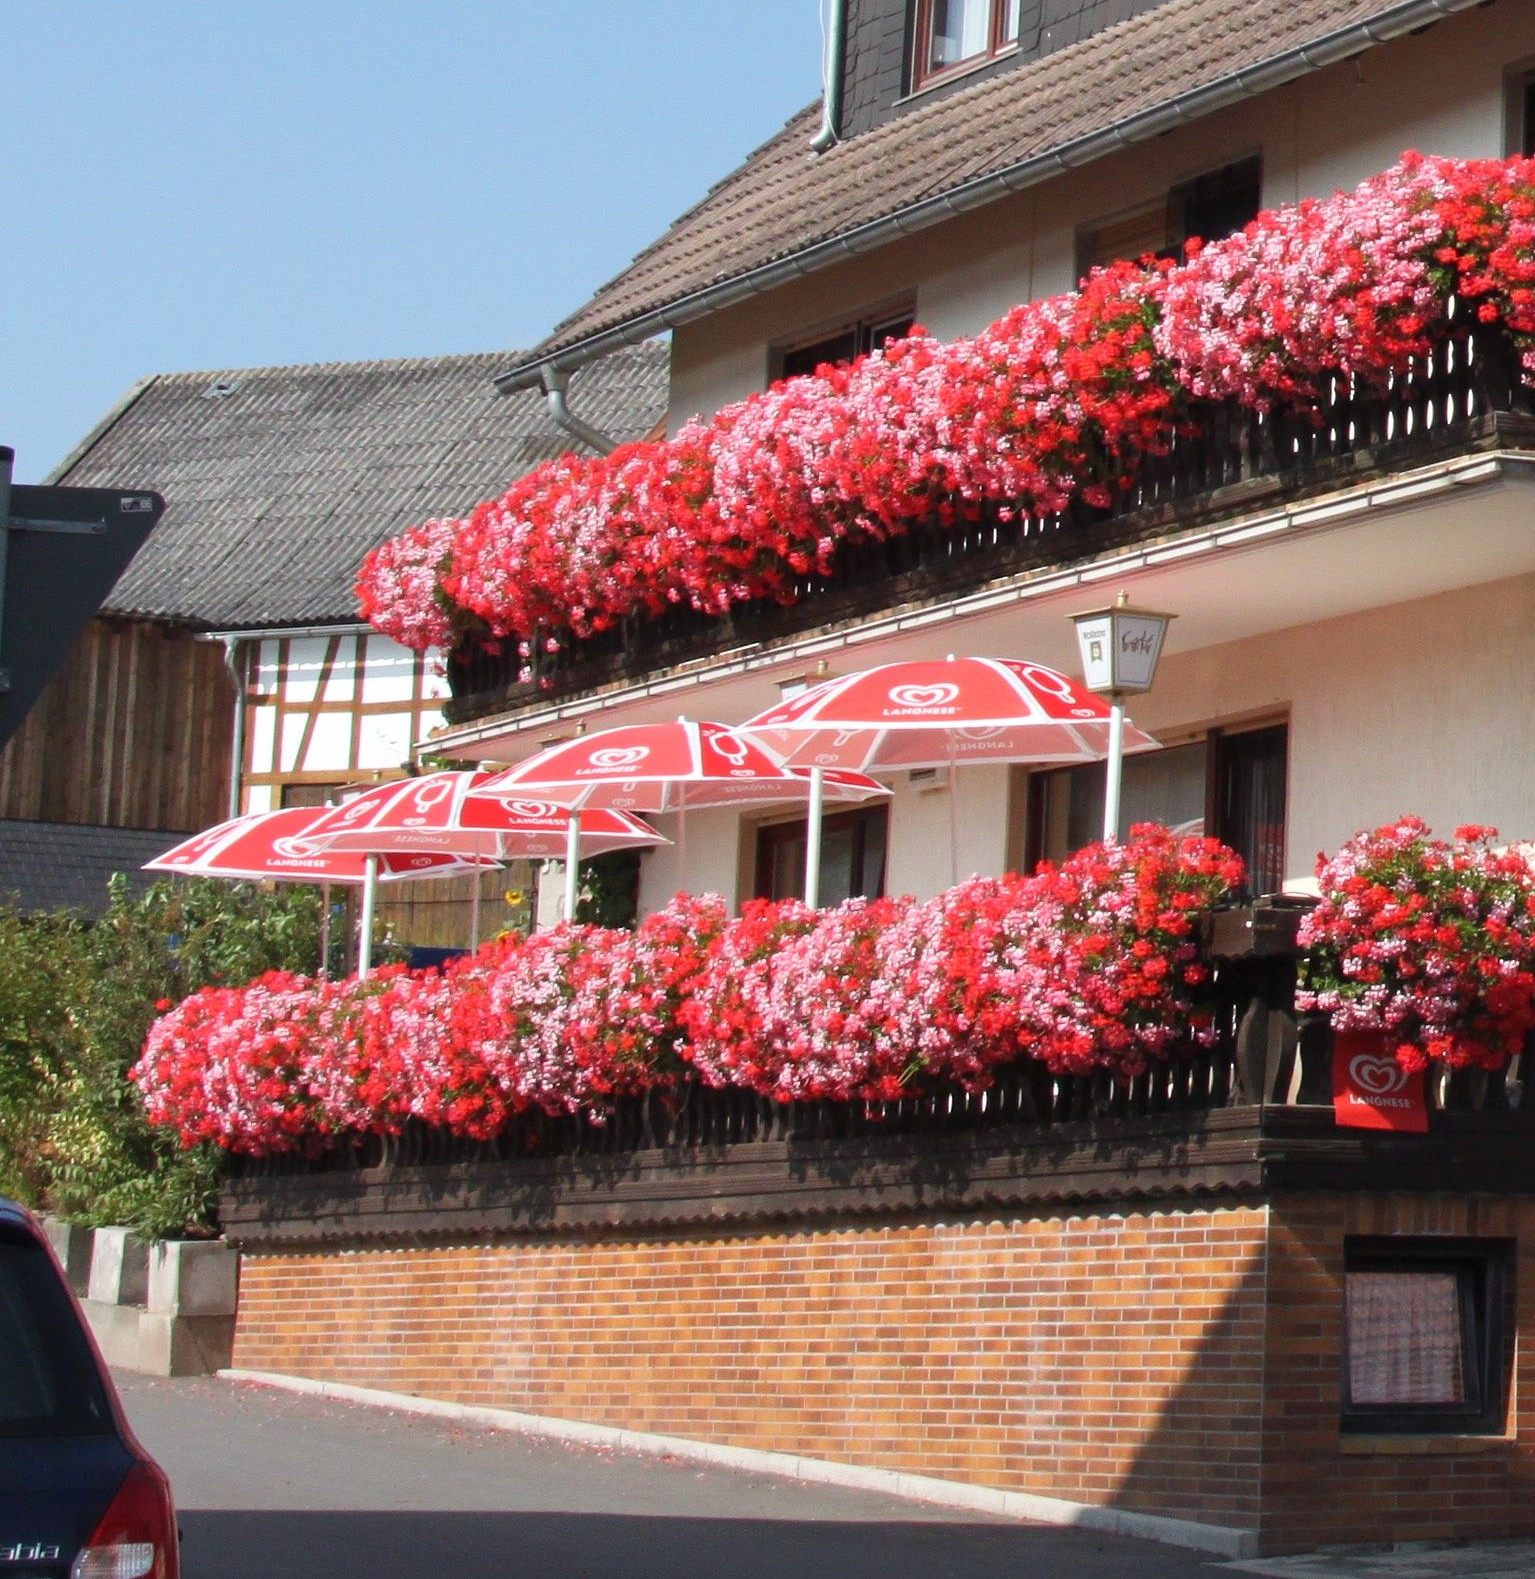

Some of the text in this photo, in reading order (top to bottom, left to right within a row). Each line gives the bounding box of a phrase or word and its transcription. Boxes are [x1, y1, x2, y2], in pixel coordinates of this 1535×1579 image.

[882, 707, 956, 716] LANGNESE
[575, 765, 637, 776] LANGNESE
[509, 817, 567, 826] LANGNESE
[266, 858, 327, 868] LANGNESE
[1349, 1094, 1411, 1108] LANGNESE
